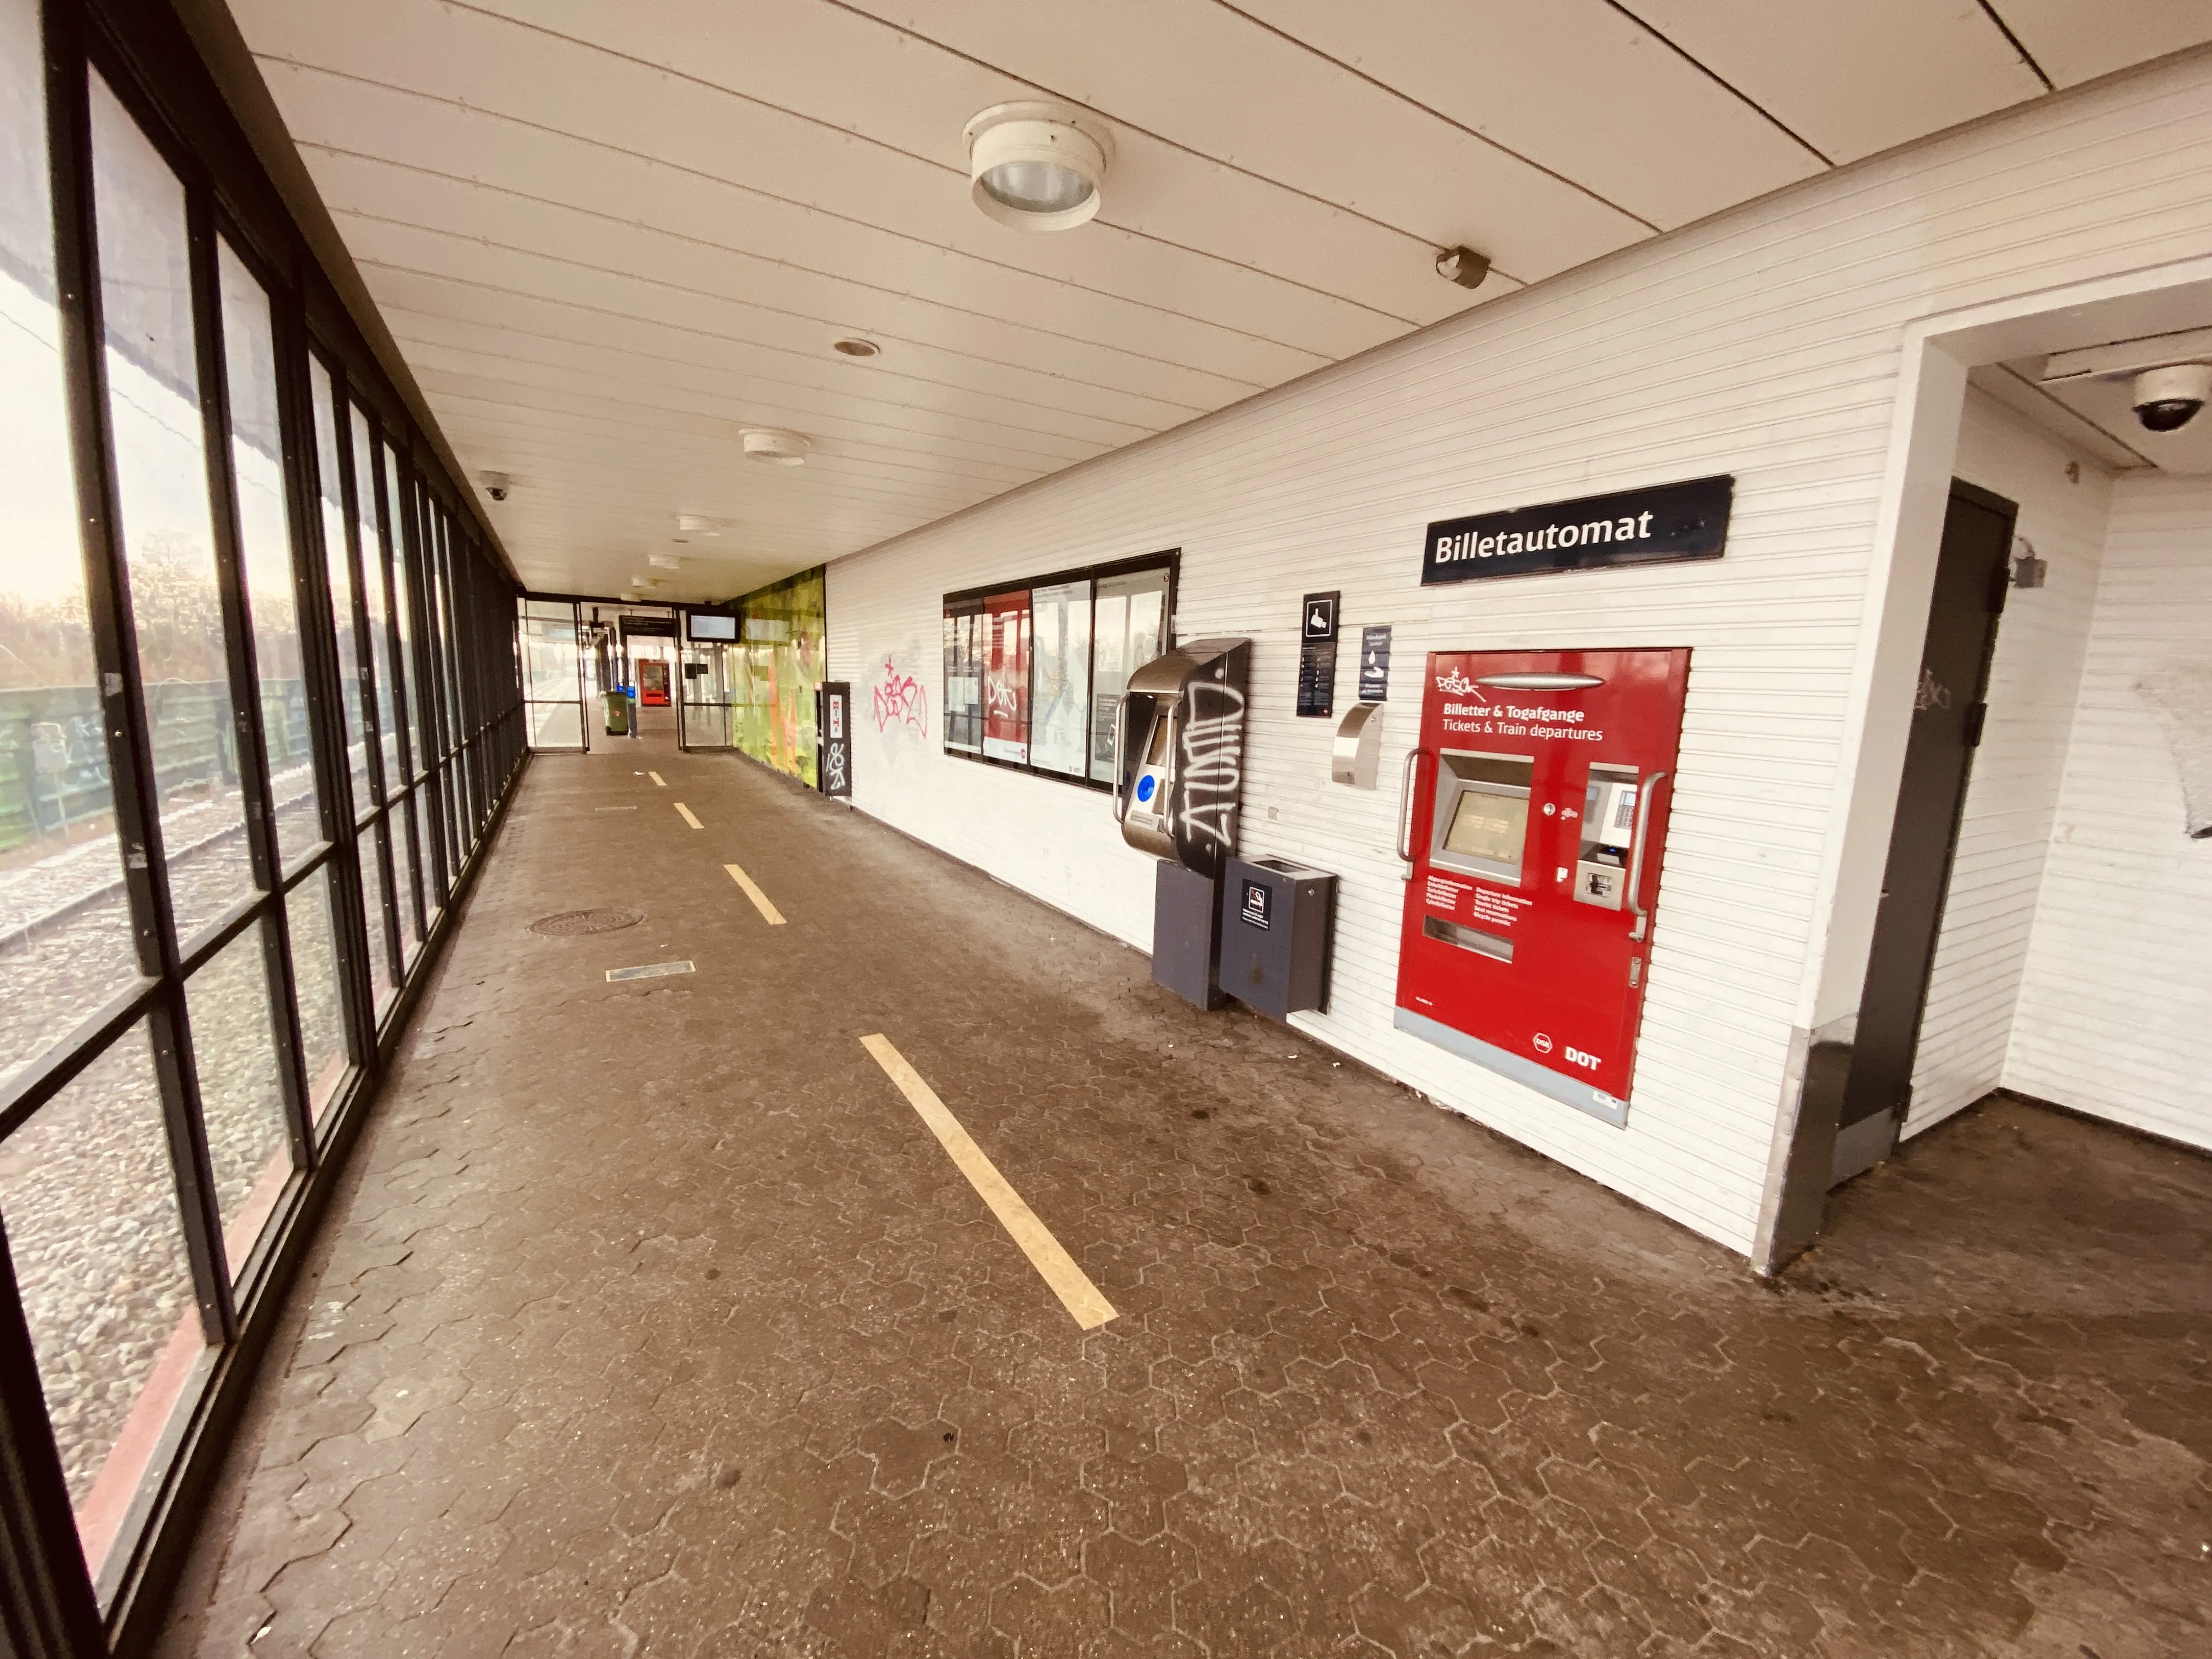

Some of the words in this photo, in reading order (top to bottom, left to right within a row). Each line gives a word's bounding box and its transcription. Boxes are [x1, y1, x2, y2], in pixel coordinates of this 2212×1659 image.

[1435, 511, 1653, 563] Billetautomat
[1443, 703, 1491, 717] Billetter
[1493, 705, 1503, 718] &
[1505, 704, 1584, 724] Togafgange
[1442, 719, 1481, 733] Tickets
[1484, 721, 1493, 734] &
[1497, 721, 1526, 736] Train
[1530, 724, 1603, 741] departures
[1475, 893, 1491, 901] Single
[1501, 900, 1519, 909] tickets
[1476, 887, 1502, 898] Departure
[1502, 893, 1533, 906] information
[1475, 899, 1492, 908] Tourist
[1492, 904, 1509, 913] tickets
[1474, 911, 1491, 921] Bicycle
[1491, 917, 1510, 927] permits
[1486, 909, 1517, 922] reservations
[1536, 1038, 1550, 1048] DSB
[1565, 1046, 1601, 1070] DOT
